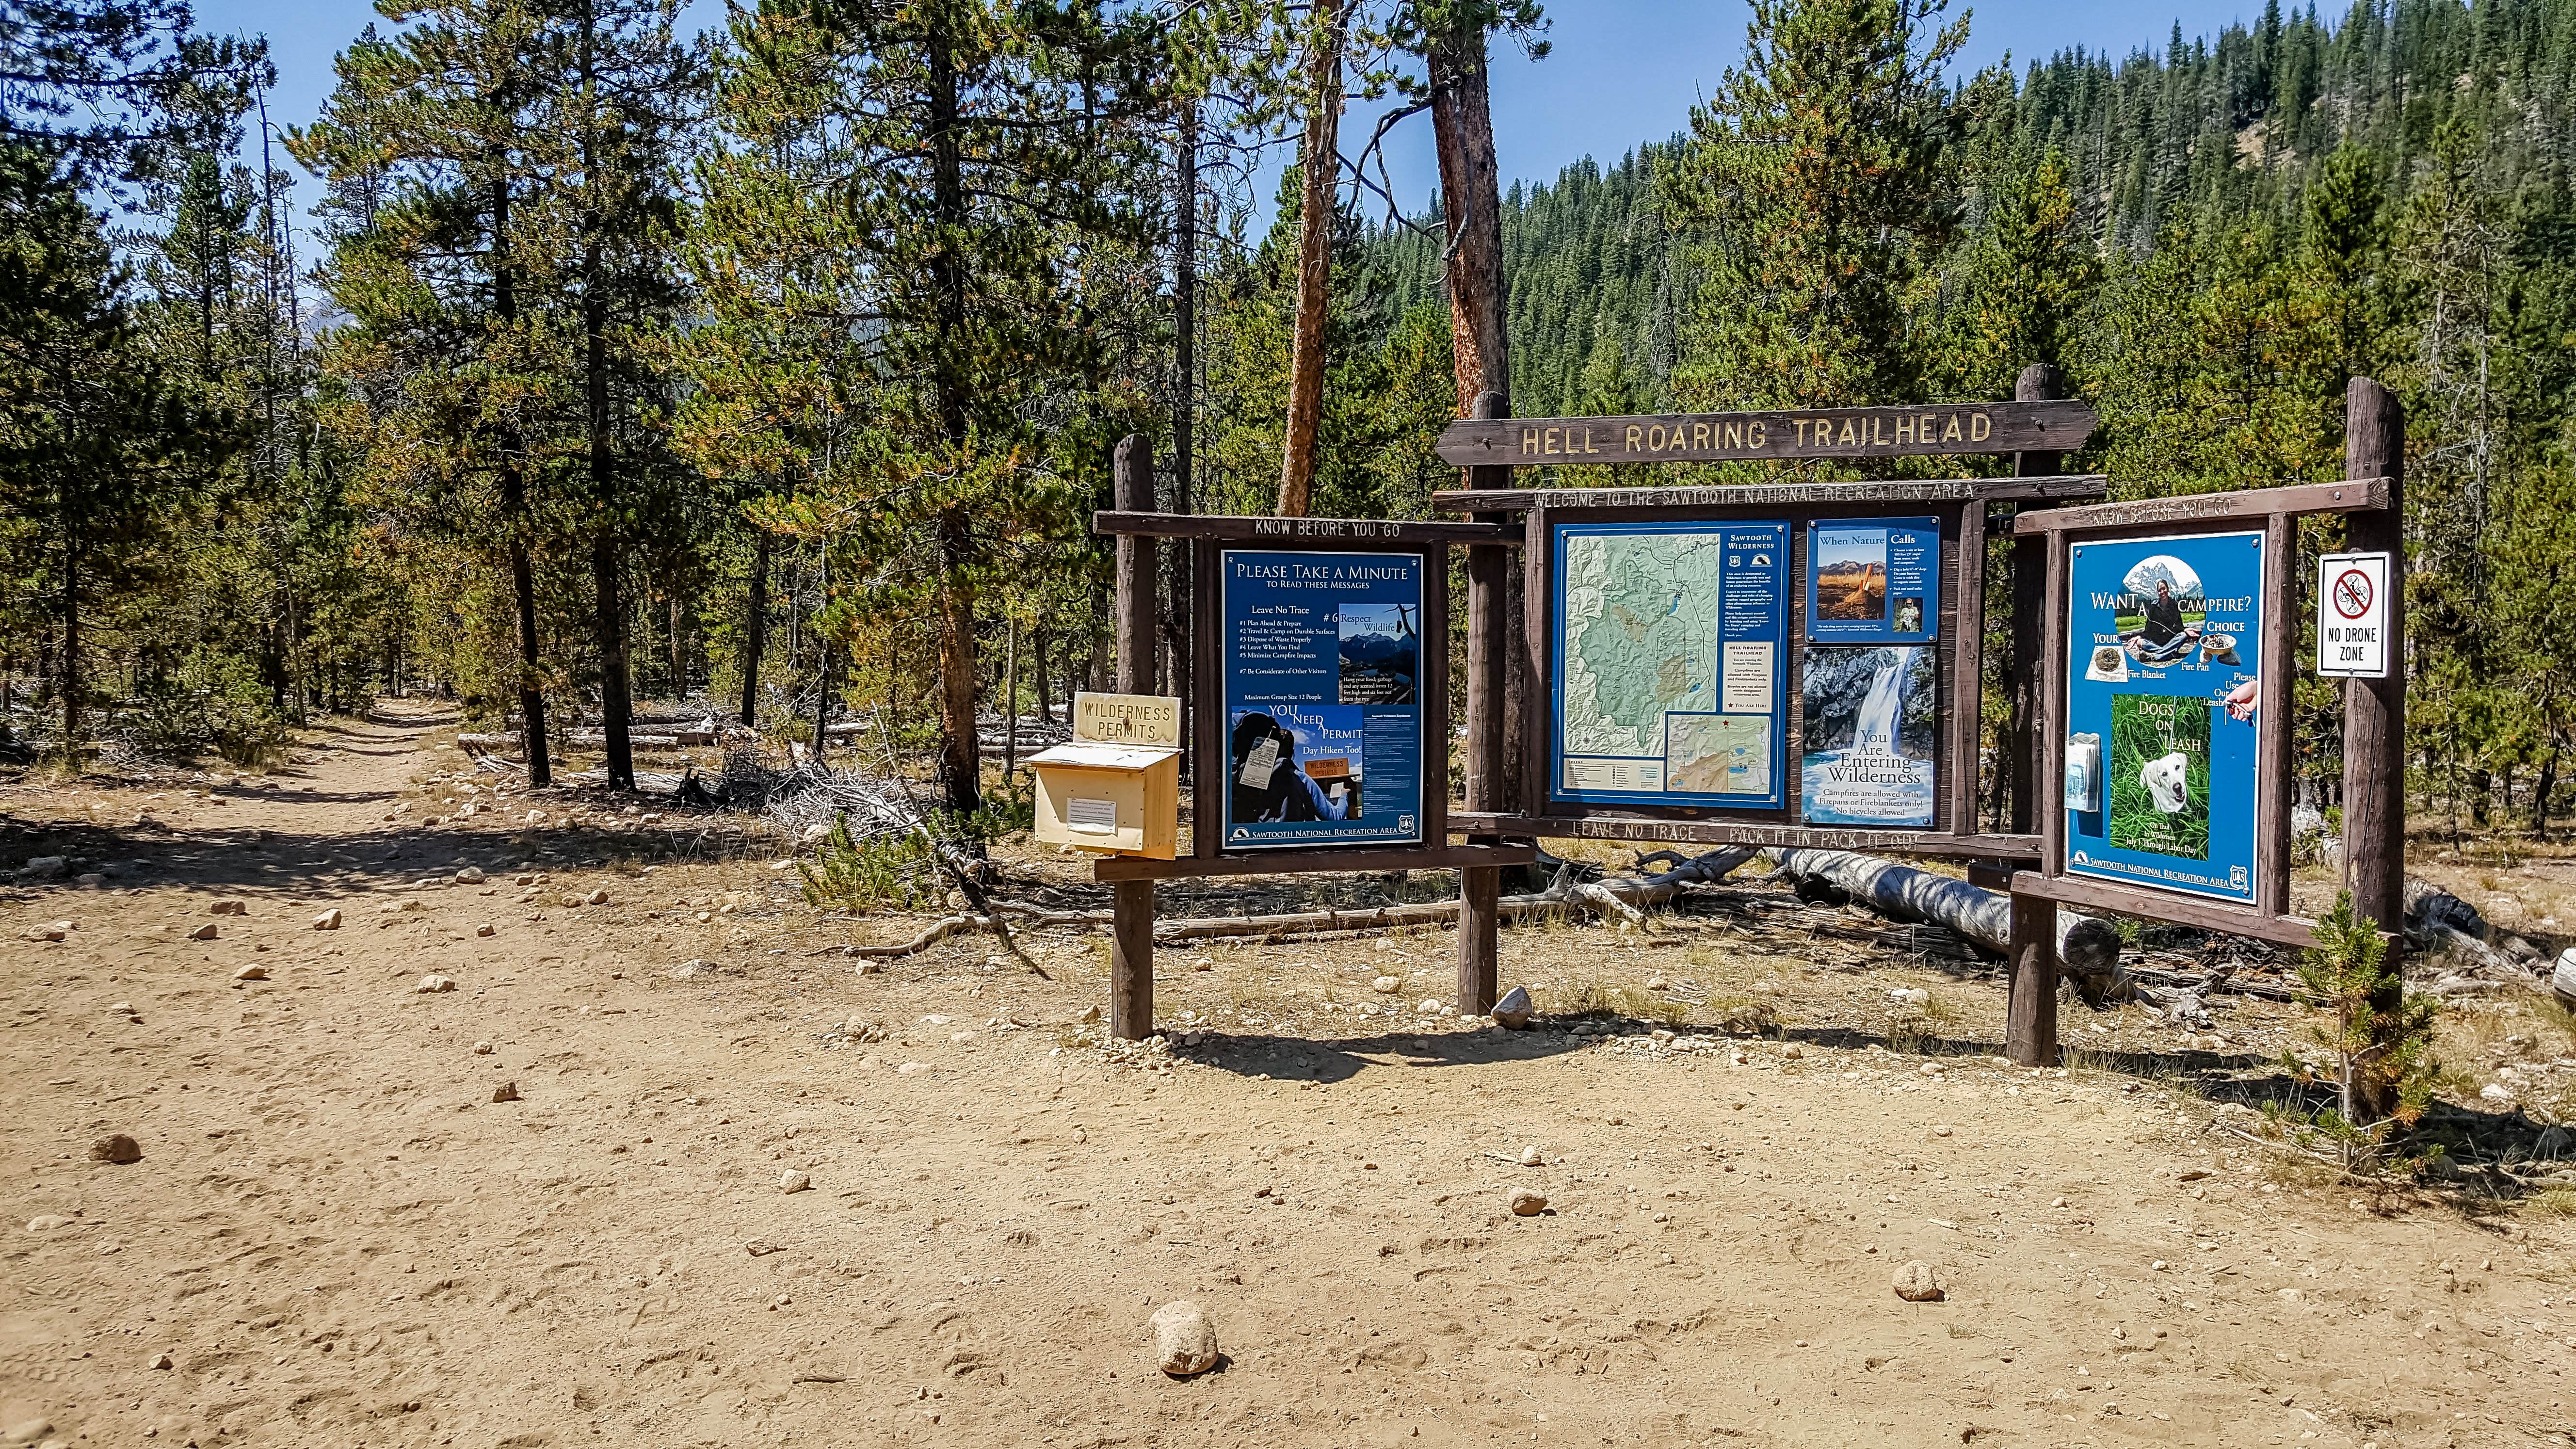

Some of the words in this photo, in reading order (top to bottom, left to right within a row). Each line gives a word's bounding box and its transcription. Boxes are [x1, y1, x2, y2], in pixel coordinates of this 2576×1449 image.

[1522, 427, 1599, 455] HELL
[1626, 421, 1766, 452] ROARING
[1793, 413, 1990, 447] TRAILHEAD
[1534, 492, 1596, 507] WELCOME
[1607, 493, 1620, 506] TO
[1628, 492, 1654, 506] THE
[1662, 490, 1736, 505] SAWTOOTH
[1745, 486, 1813, 503] NATIONAL
[1825, 485, 1921, 501] RECREATION
[1931, 484, 1974, 499] AREA
[2093, 507, 2123, 525] KNOW
[2182, 499, 2206, 518] YOU
[2214, 497, 2231, 515] GO
[1256, 520, 1290, 534] KNOW
[1298, 520, 1345, 536] BEFORE
[1352, 523, 1376, 537] YOU
[1384, 524, 1400, 537] GO
[1819, 536, 1848, 546] When
[1852, 536, 1884, 545] Nature
[1891, 535, 1915, 544] Calls
[1237, 564, 1287, 578] PLEASE
[1292, 564, 1329, 579] TAKE
[1334, 569, 1343, 579] A
[1349, 566, 1408, 580] MINUTE
[1281, 580, 1302, 588] READ
[1331, 581, 1369, 589] MESSAGES
[2090, 592, 2138, 610] WANT
[2138, 602, 2147, 616] A
[2177, 596, 2251, 612] CAMPFIRE?
[1275, 606, 1287, 614] No
[1289, 606, 1309, 614] Trace
[1332, 612, 1337, 622] 6
[1340, 614, 1371, 625] Respect
[1364, 623, 1395, 631] Wildlife
[2207, 621, 2245, 631] CHOICE
[2093, 633, 2119, 644] YOUR
[2328, 628, 2340, 642] NO
[2346, 628, 2376, 642] DRONE
[2340, 646, 2364, 661] ZONE
[2181, 662, 2194, 671] Fire
[2141, 670, 2166, 679] Blanket
[2234, 672, 2255, 681] Please
[2225, 680, 2239, 689] Use
[2214, 688, 2229, 697] Our
[2203, 697, 2224, 706] Leash
[1085, 702, 1171, 721] WILDERNESS
[1269, 705, 1298, 716] YOU
[2139, 701, 2173, 716] DOGS
[1293, 714, 1323, 724] NEED
[1098, 722, 1156, 739] PERMITS
[1318, 722, 1324, 730] A
[2156, 720, 2173, 730] ON
[1322, 729, 1363, 739] PERMIT
[1860, 730, 1888, 743] You
[2165, 736, 2201, 751] LEASH
[1303, 746, 1318, 756] Day
[1320, 746, 1344, 754] Hikers
[1345, 745, 1361, 754] Too!
[1857, 744, 1883, 756] Are
[1839, 753, 1911, 773] Entering
[1827, 767, 1920, 784] Wilderness
[1823, 789, 1859, 798] Campfires
[1819, 798, 1848, 807] Firepans
[1860, 799, 1903, 807] Fireblankets
[1905, 800, 1923, 808] only!
[1849, 807, 1876, 816] bicycles
[1335, 828, 1379, 836] RECREATION
[1571, 821, 1616, 837] LEAVE
[1626, 824, 1643, 838] NO
[1653, 823, 1696, 840] TRACE
[2151, 831, 2175, 840] Wilderness
[1729, 827, 1764, 844] PACK
[1774, 830, 1787, 844] IT
[1797, 831, 1811, 845] IN
[1821, 833, 1857, 848] PACK
[1890, 834, 1920, 851] OUT
[2126, 837, 2137, 847] July
[2143, 839, 2165, 851] Through
[2167, 843, 2184, 852] Labor
[2185, 845, 2196, 856] Day
[2090, 857, 2125, 870] SAWTOOTH
[2127, 863, 2161, 876] NATIONAL
[2164, 869, 2207, 884] RECREATION
[2209, 876, 2228, 887] AREA
